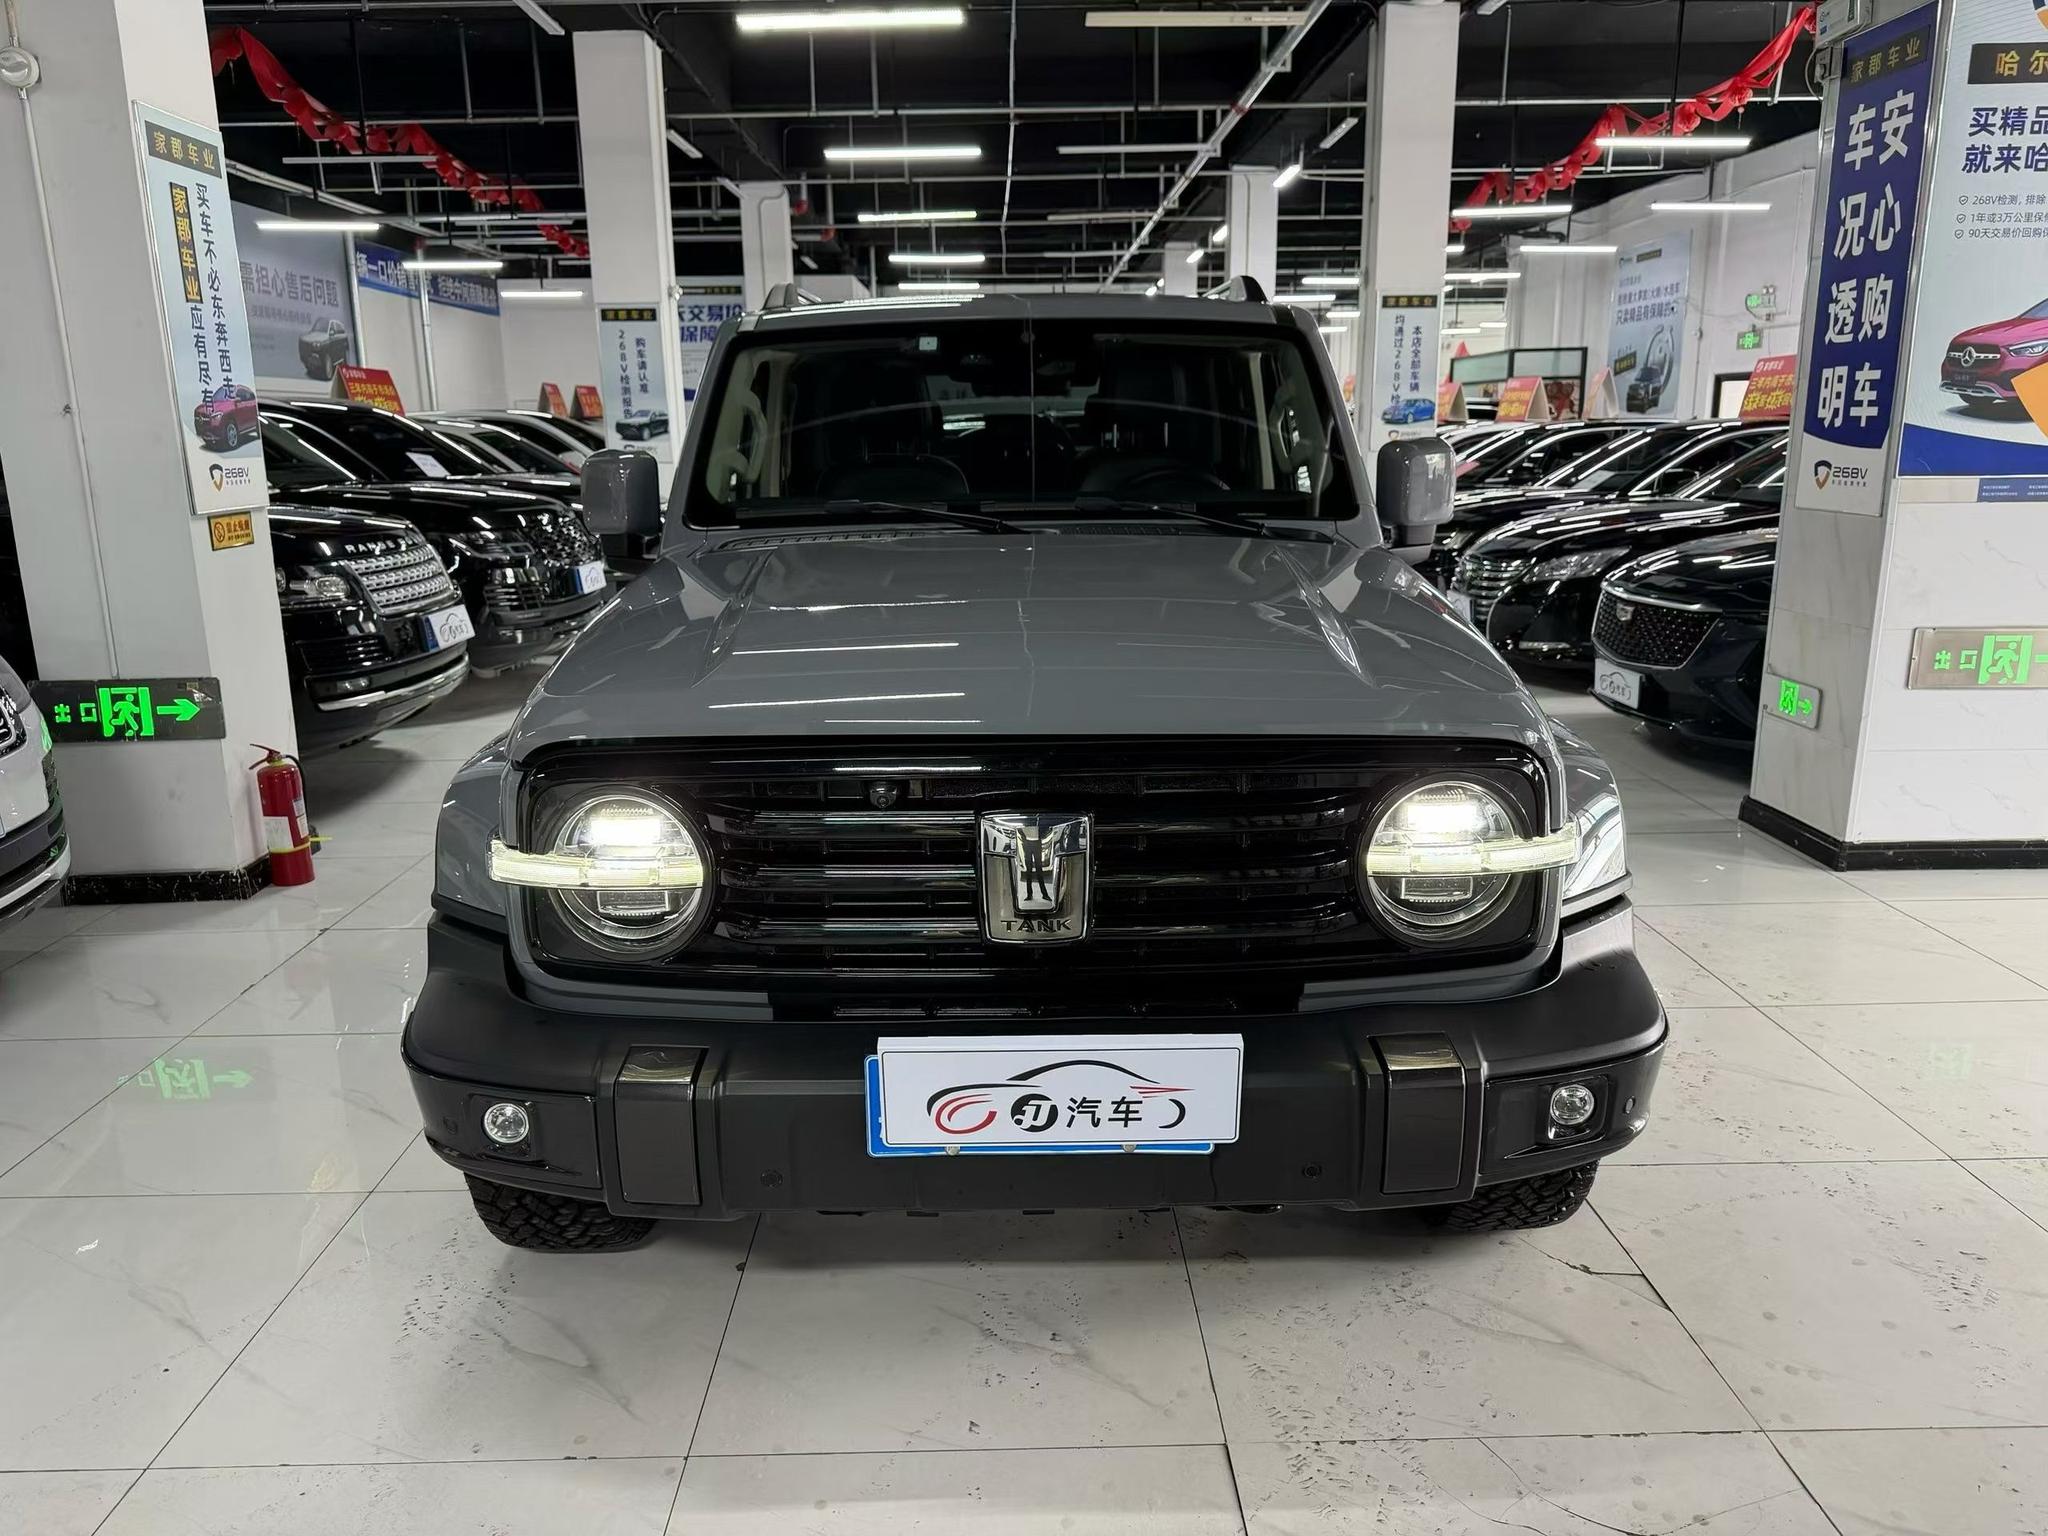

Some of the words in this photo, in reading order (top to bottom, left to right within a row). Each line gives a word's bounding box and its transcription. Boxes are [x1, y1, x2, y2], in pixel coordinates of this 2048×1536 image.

[1851, 37, 1920, 82] 家郡车业
[1968, 106, 2048, 137] 买精品
[153, 131, 215, 170] 家郡车业
[195, 182, 236, 400] 买车不必东奔西走
[224, 467, 249, 479] 268V
[1832, 466, 1868, 479] 268V
[1933, 650, 1978, 670] 出口
[54, 702, 97, 723] 出口
[1001, 919, 1072, 933] TANK
